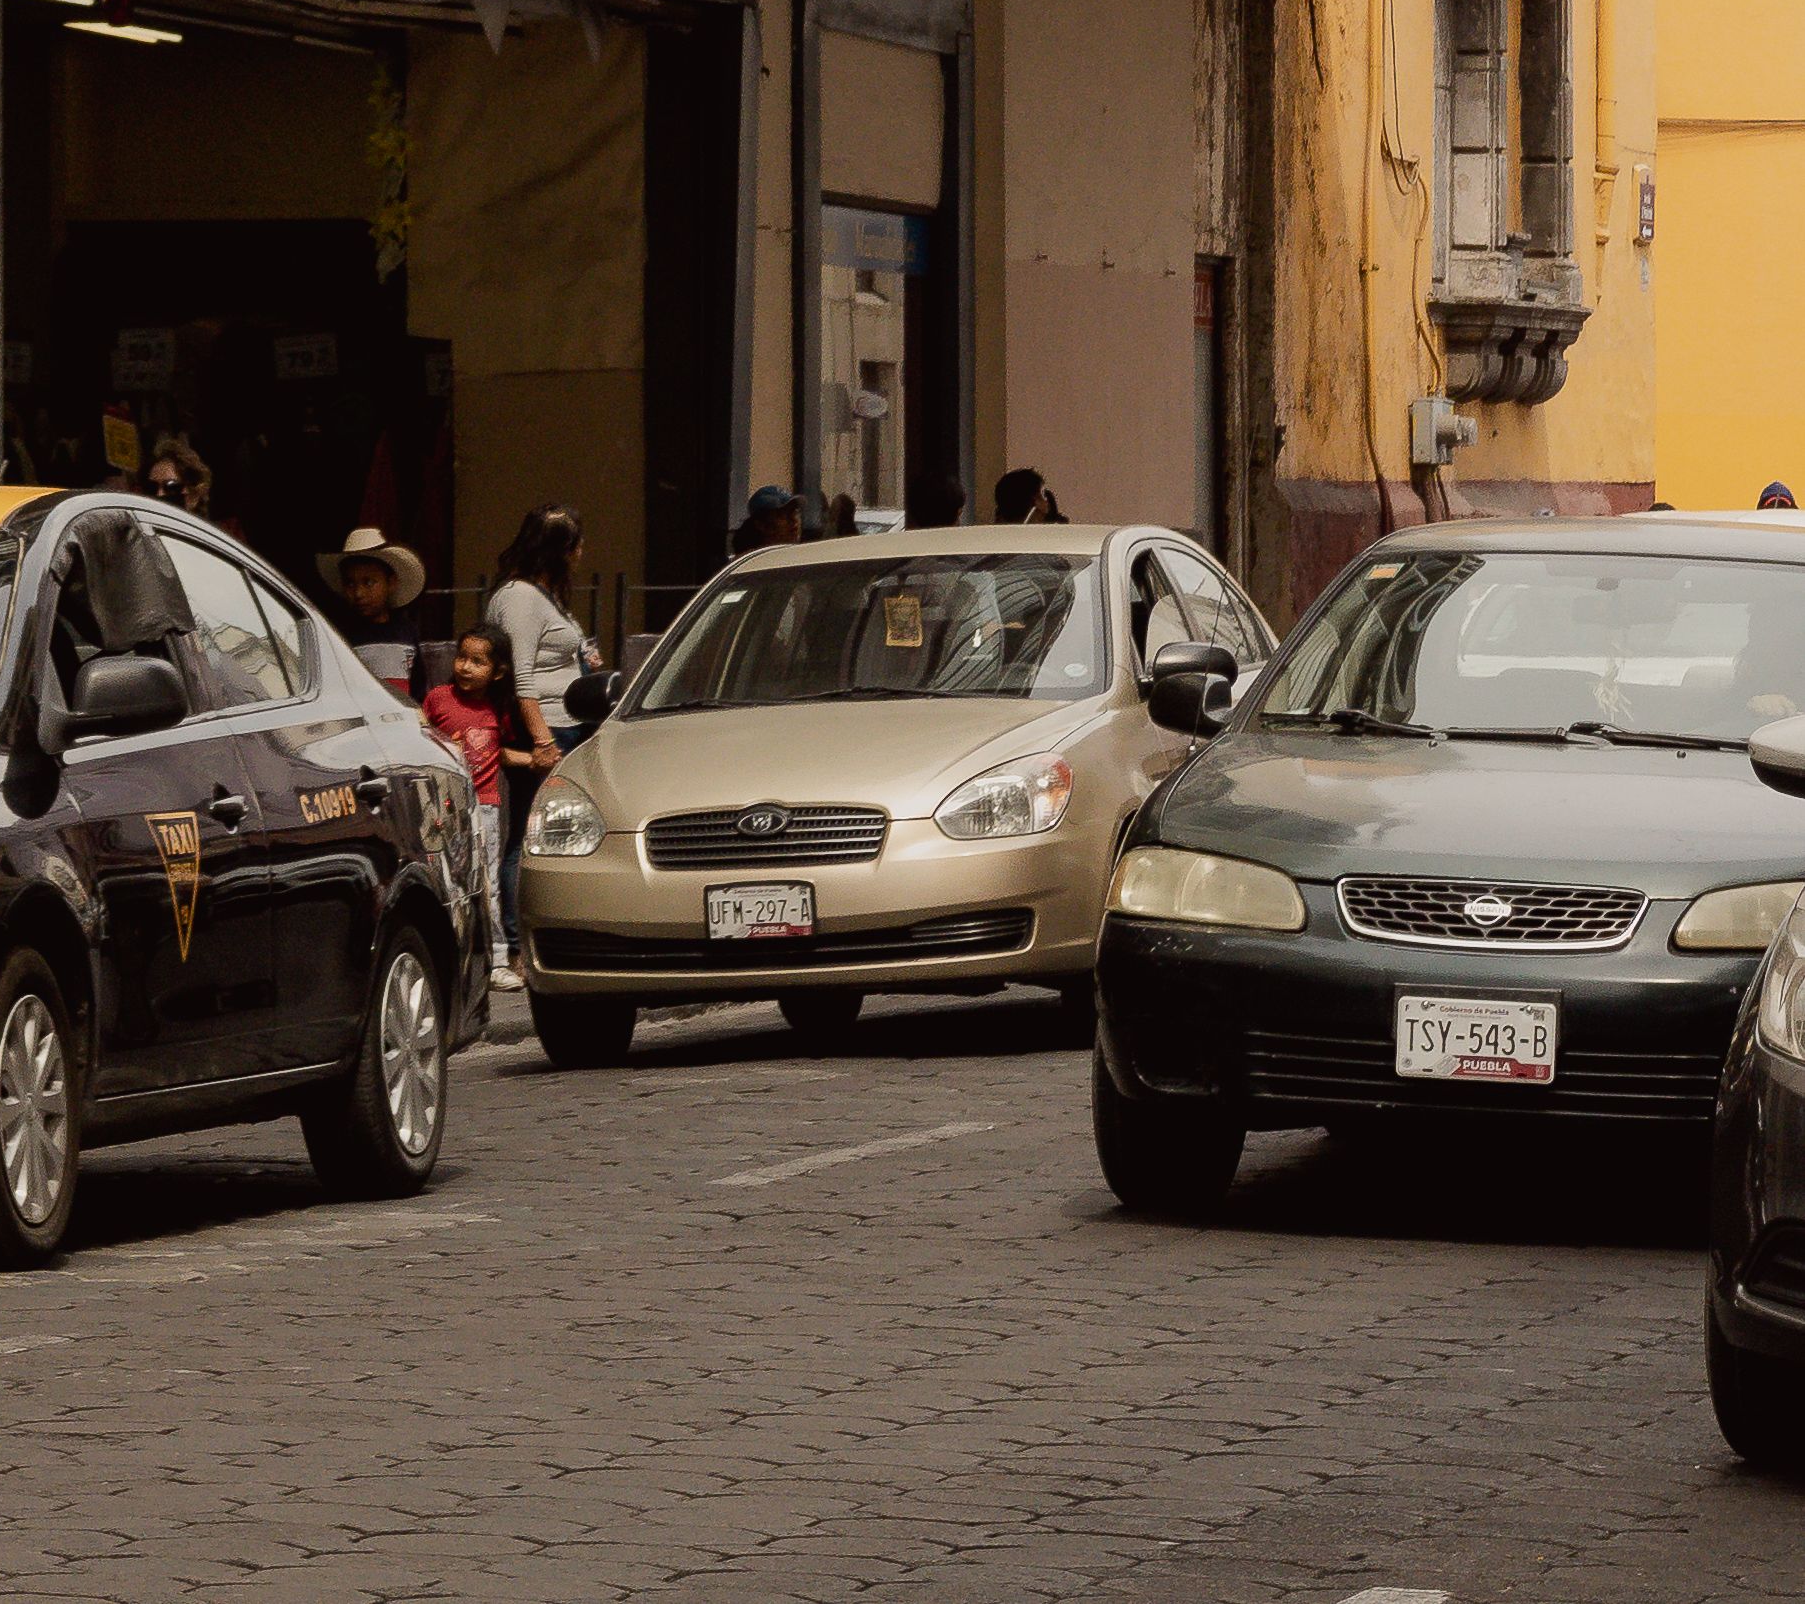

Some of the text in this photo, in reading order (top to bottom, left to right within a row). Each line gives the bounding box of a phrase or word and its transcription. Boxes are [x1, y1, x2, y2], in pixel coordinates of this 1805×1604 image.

[299, 785, 357, 823] C.10919
[158, 823, 195, 855] TAXI
[709, 897, 811, 925] UFM-297-A
[1468, 904, 1506, 914] NISSAN
[1440, 1005, 1510, 1016] Gobierno de Puebla
[1405, 1018, 1547, 1058] TSY-543-B
[1462, 1060, 1512, 1072] PUEBLA
